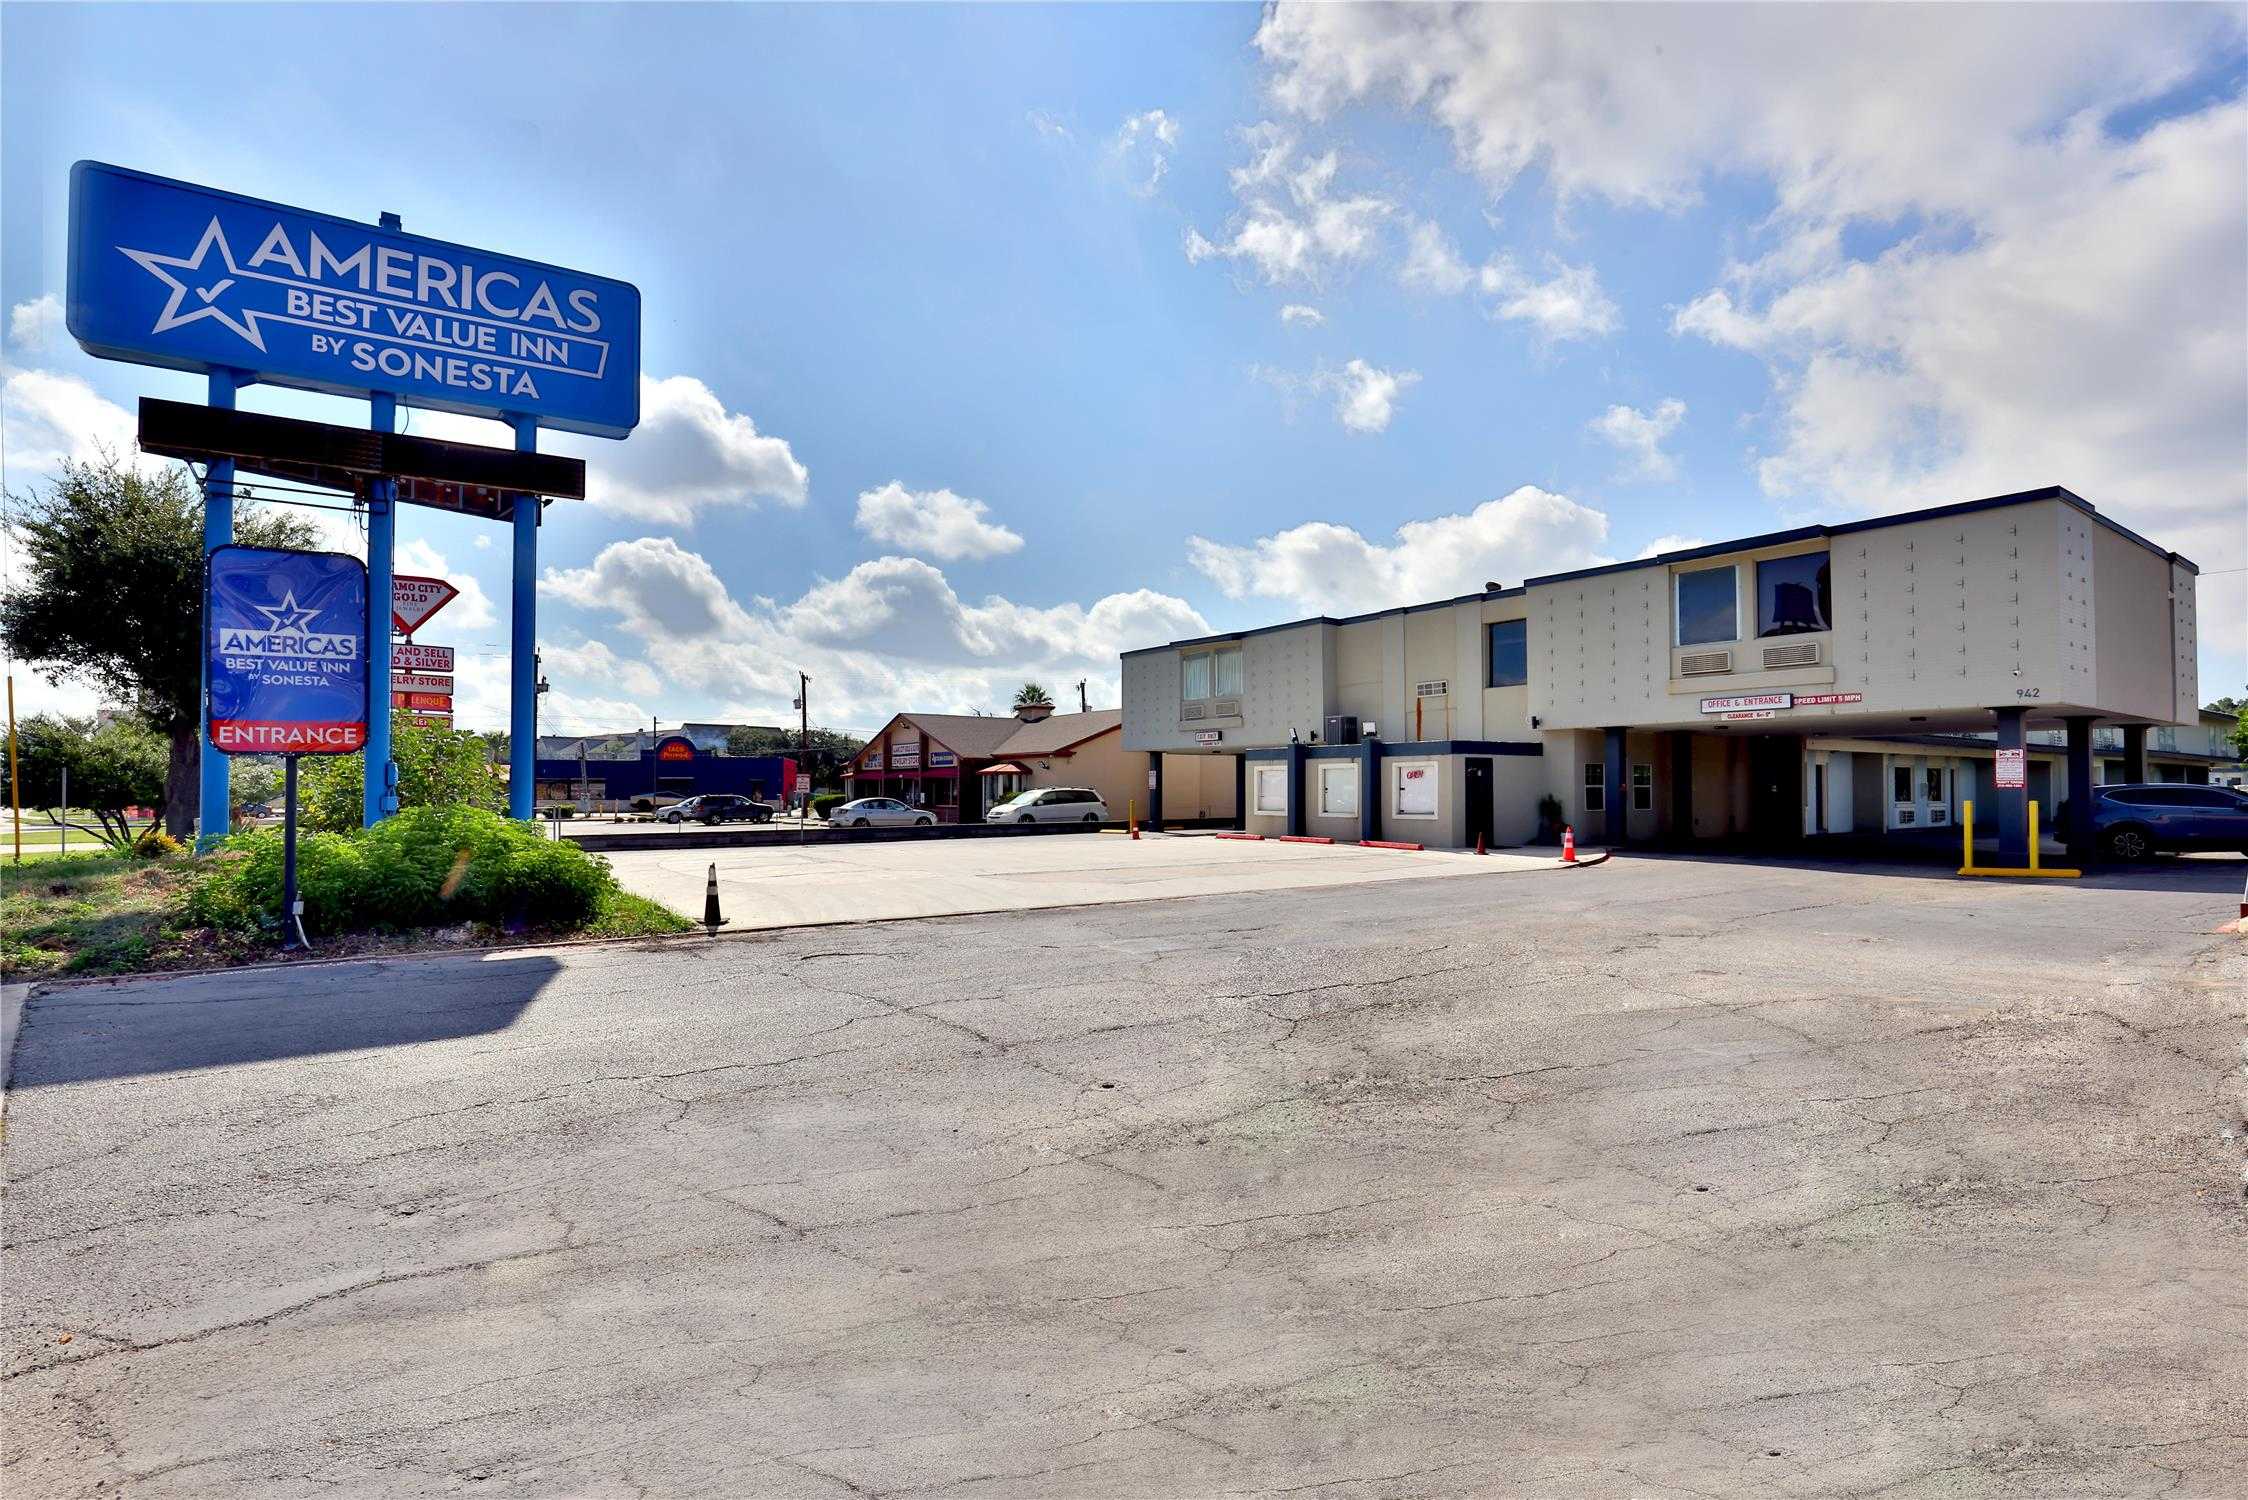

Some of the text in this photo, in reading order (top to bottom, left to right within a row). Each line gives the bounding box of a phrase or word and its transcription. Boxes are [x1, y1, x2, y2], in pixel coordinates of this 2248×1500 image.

[247, 222, 601, 333] AMERICAS
[287, 288, 569, 367] BEST VALUE INN
[312, 334, 541, 400] BY SONESTA
[392, 582, 442, 594] AMO CITY
[393, 592, 428, 603] GOLD
[223, 632, 354, 657] AMERICAS
[396, 646, 448, 659] AND SELL
[225, 657, 350, 673] BEST VALUE INN
[404, 657, 412, 666] &
[415, 658, 450, 669] SILVER
[262, 674, 330, 687] SONESTA
[392, 675, 451, 687] ELRY STORE
[397, 693, 445, 705] PLENQUE
[1793, 697, 1815, 705] SPEED
[1817, 695, 1837, 704] LIMIT
[1844, 694, 1861, 702] MPH
[2016, 687, 2040, 699] 942
[1707, 699, 1731, 709] OFFICE
[1743, 696, 1784, 706] ENTRANCE
[218, 726, 358, 744] ENTRANCE
